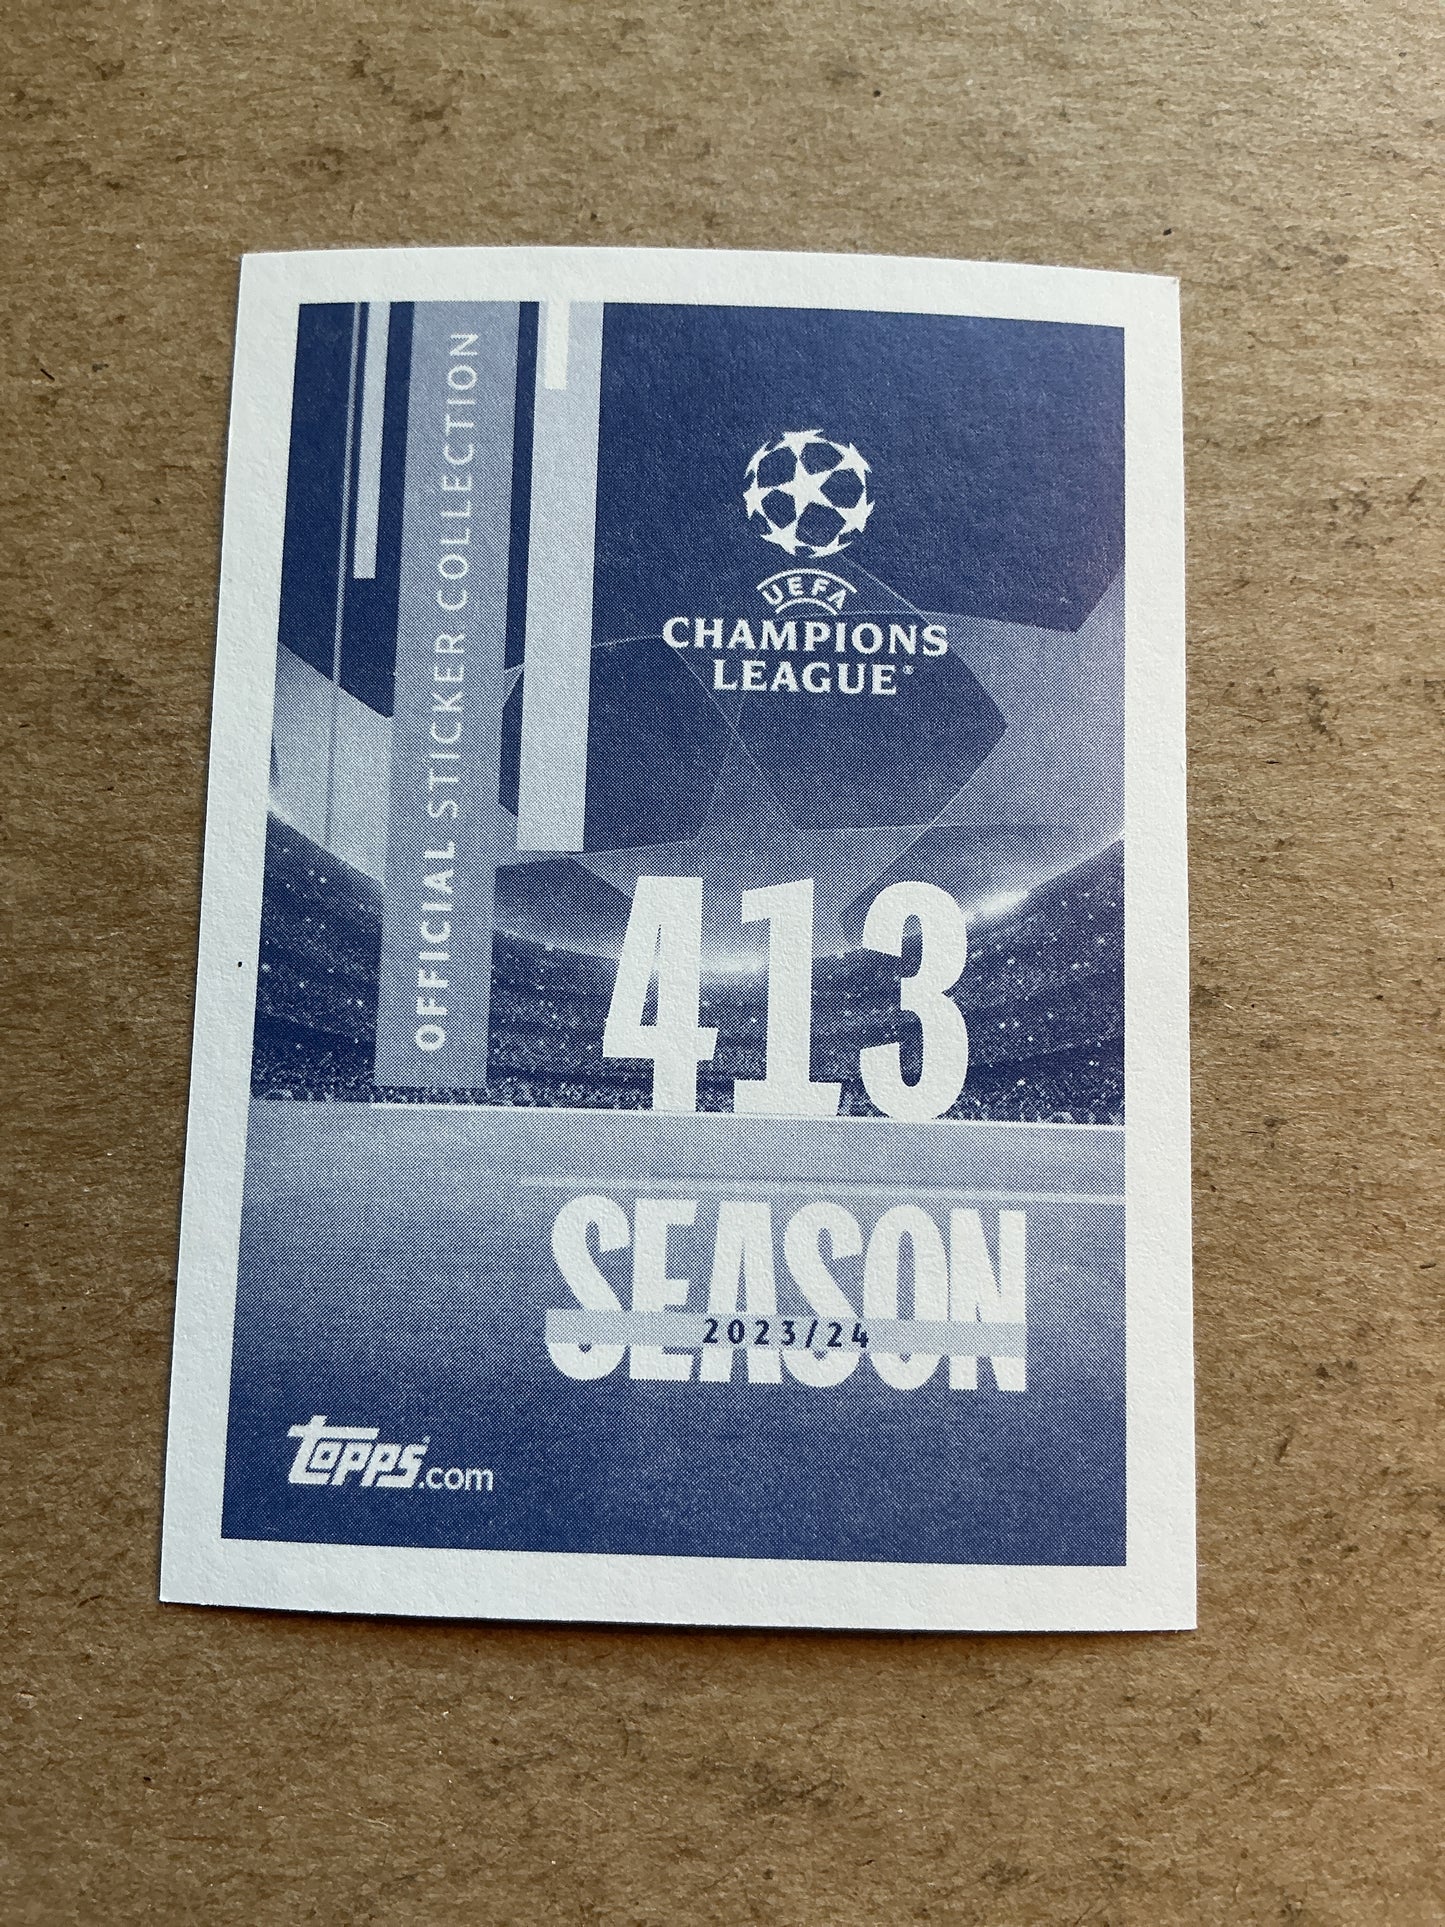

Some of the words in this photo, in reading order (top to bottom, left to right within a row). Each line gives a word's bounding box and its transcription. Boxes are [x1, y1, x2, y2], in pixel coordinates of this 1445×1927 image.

[436, 331, 480, 612] COLLECTION
[662, 616, 950, 657] CHAMPIONS
[761, 576, 848, 610] UEFA
[426, 631, 466, 820] STICKER
[415, 840, 457, 1052] OFFICIAL
[602, 875, 970, 1122] 413
[545, 1194, 1027, 1392] SEASON
[702, 1317, 870, 1349] 2023/24
